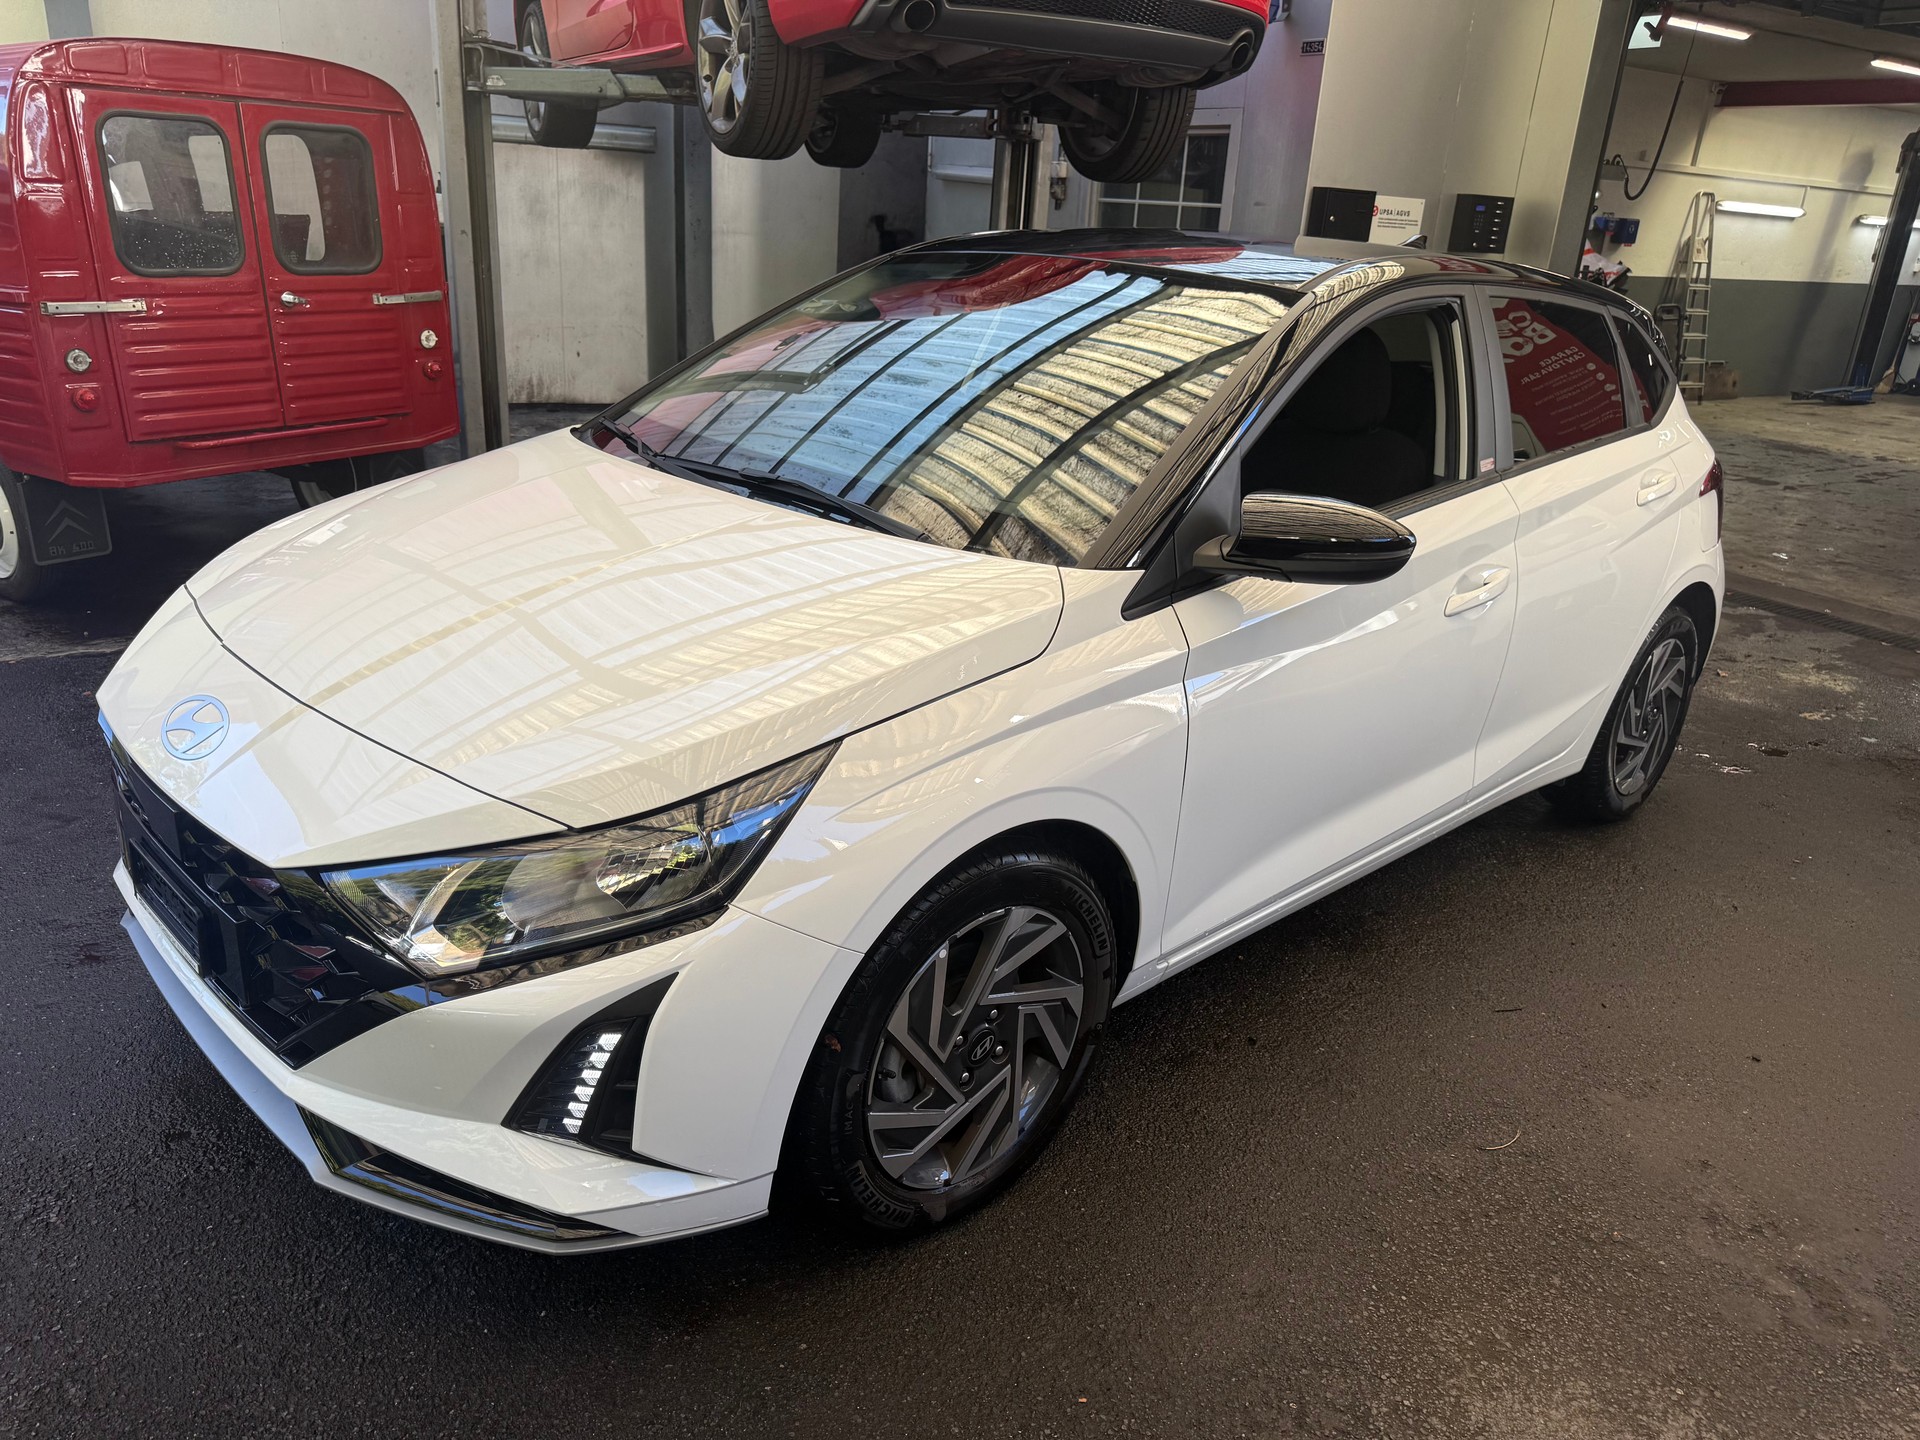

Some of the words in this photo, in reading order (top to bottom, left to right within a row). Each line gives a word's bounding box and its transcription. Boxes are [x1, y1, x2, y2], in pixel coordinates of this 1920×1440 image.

[1303, 42, 1323, 52] 14354
[1067, 886, 1109, 951] MICHELIN
[846, 1165, 911, 1224] MICHELIN
